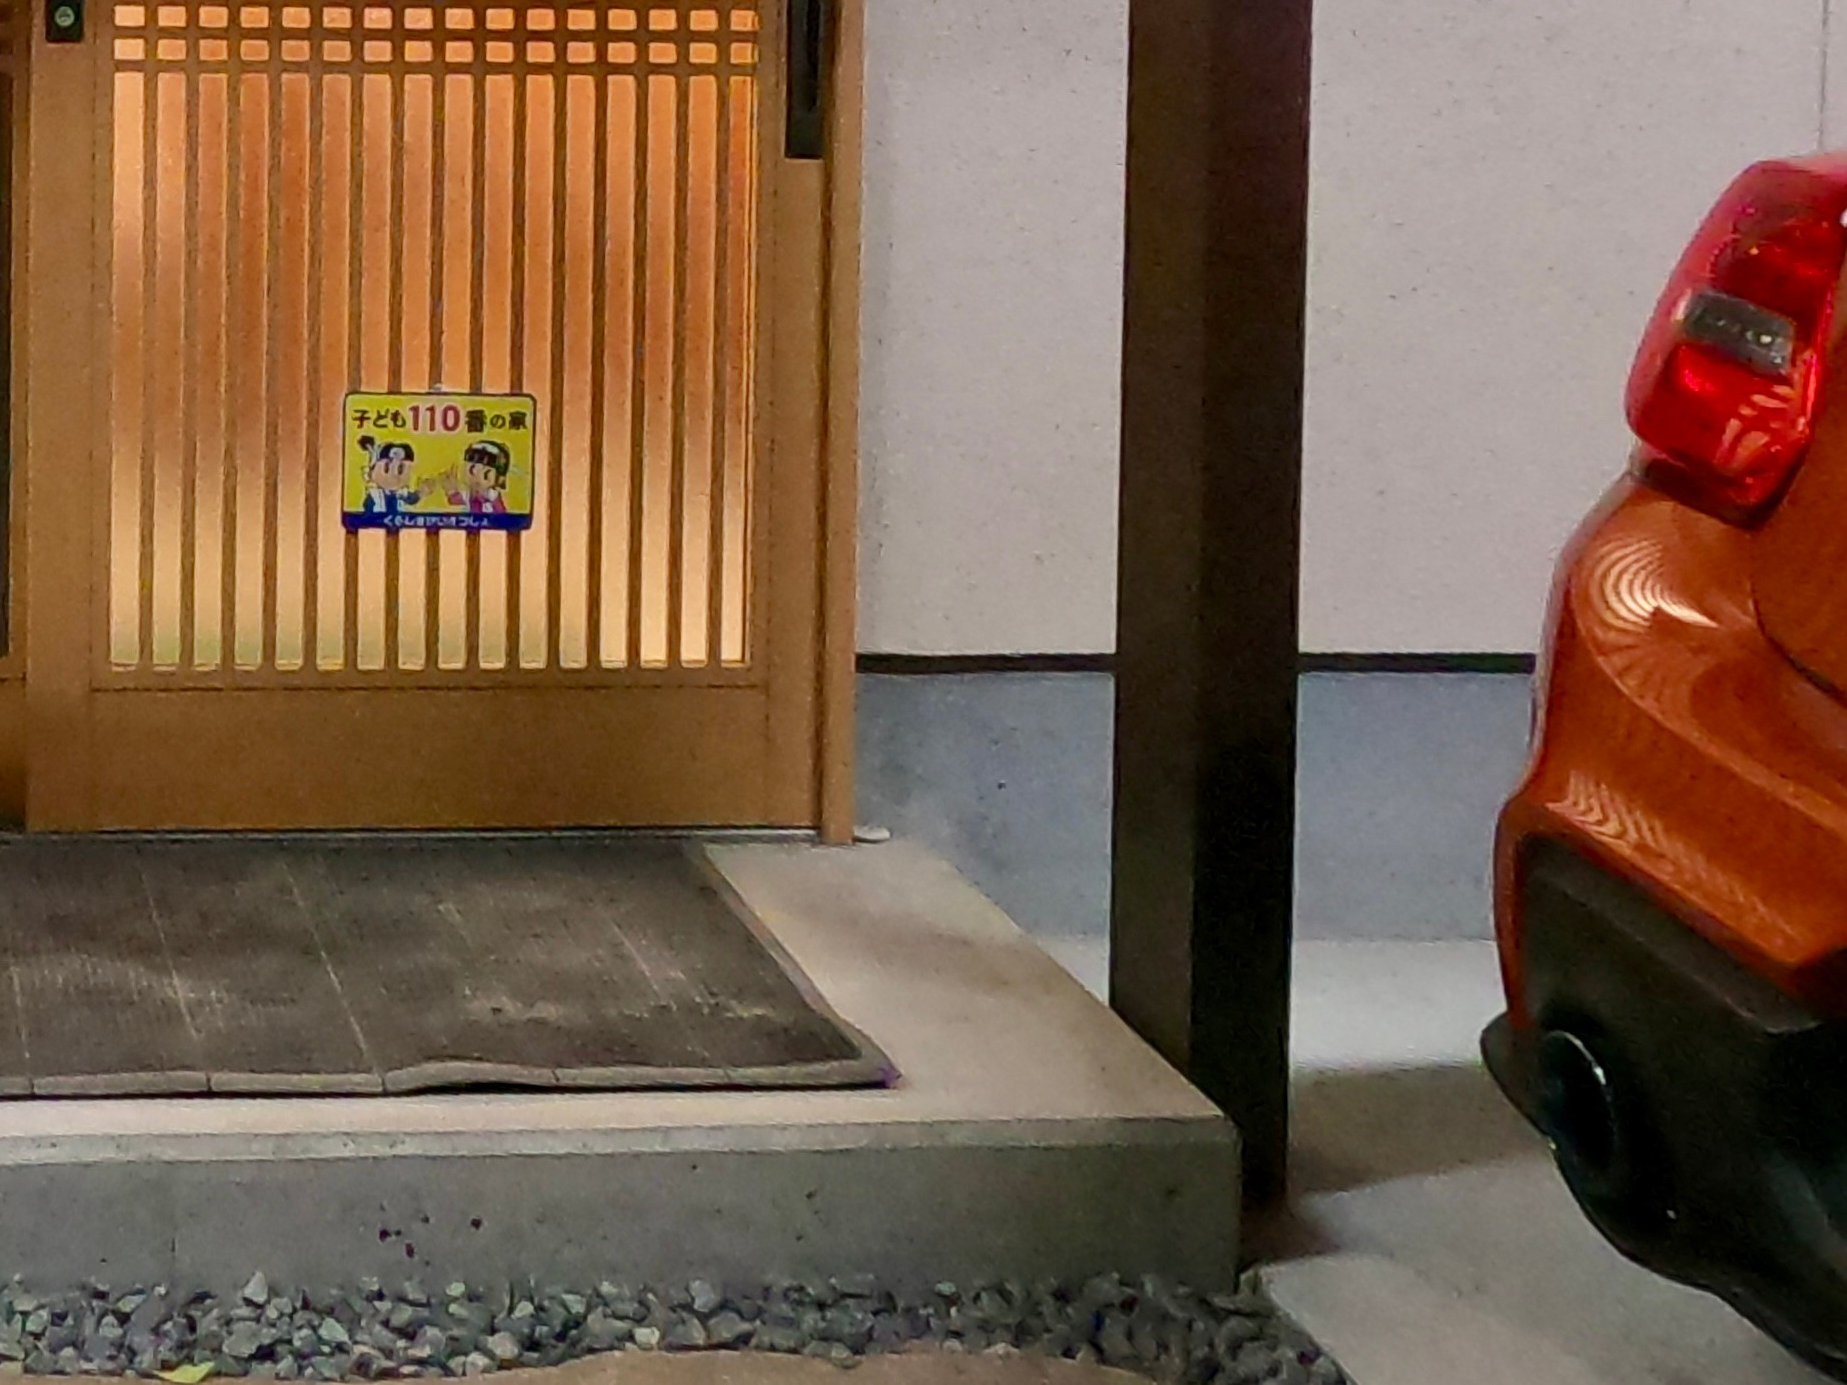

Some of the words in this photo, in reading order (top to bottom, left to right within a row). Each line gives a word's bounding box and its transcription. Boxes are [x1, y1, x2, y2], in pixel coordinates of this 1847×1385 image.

[352, 404, 528, 433] 子ども110番の家
